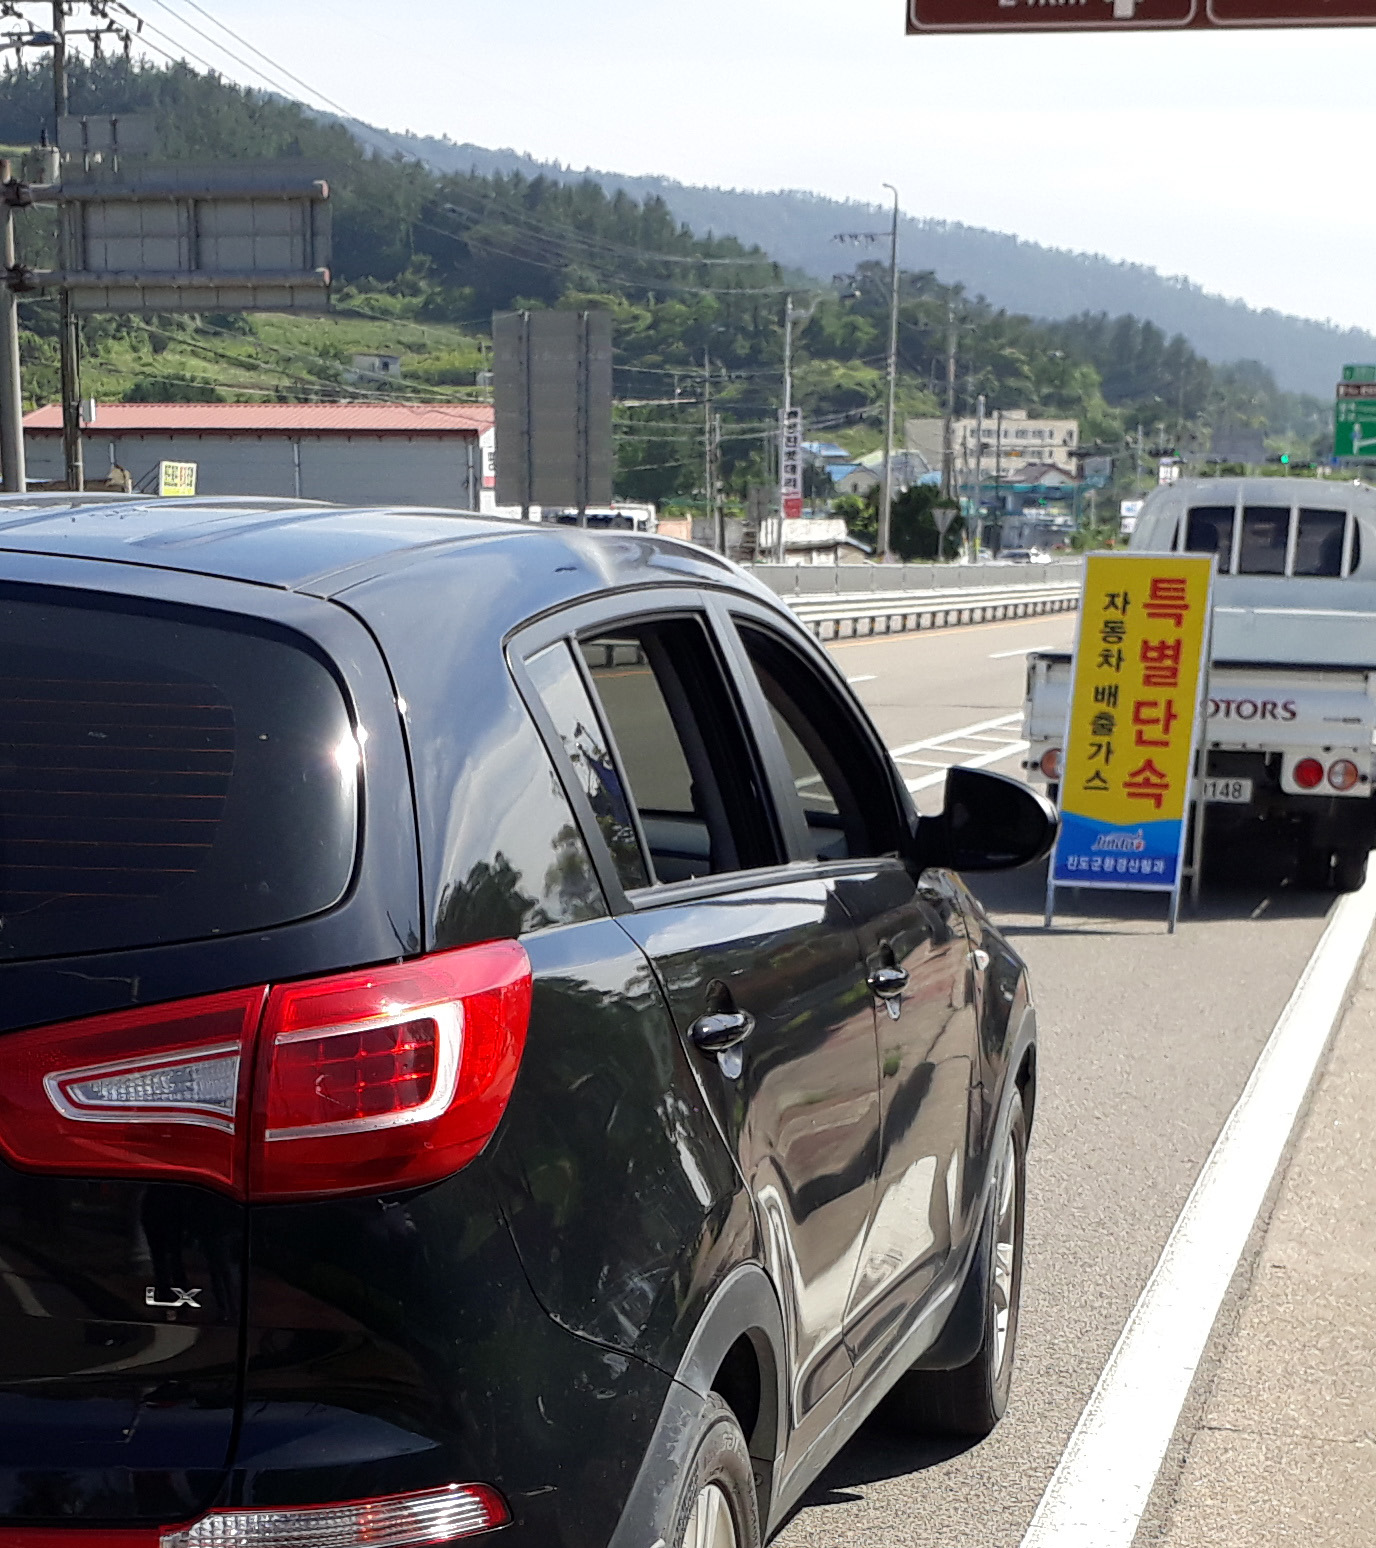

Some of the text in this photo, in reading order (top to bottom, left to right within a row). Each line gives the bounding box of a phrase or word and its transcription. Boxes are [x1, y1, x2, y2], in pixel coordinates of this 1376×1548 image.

[1083, 591, 1131, 791] 자동차 배출가스
[1122, 577, 1190, 809] 특별단속
[1208, 699, 1297, 720] OTORS
[145, 1286, 202, 1309] LX
